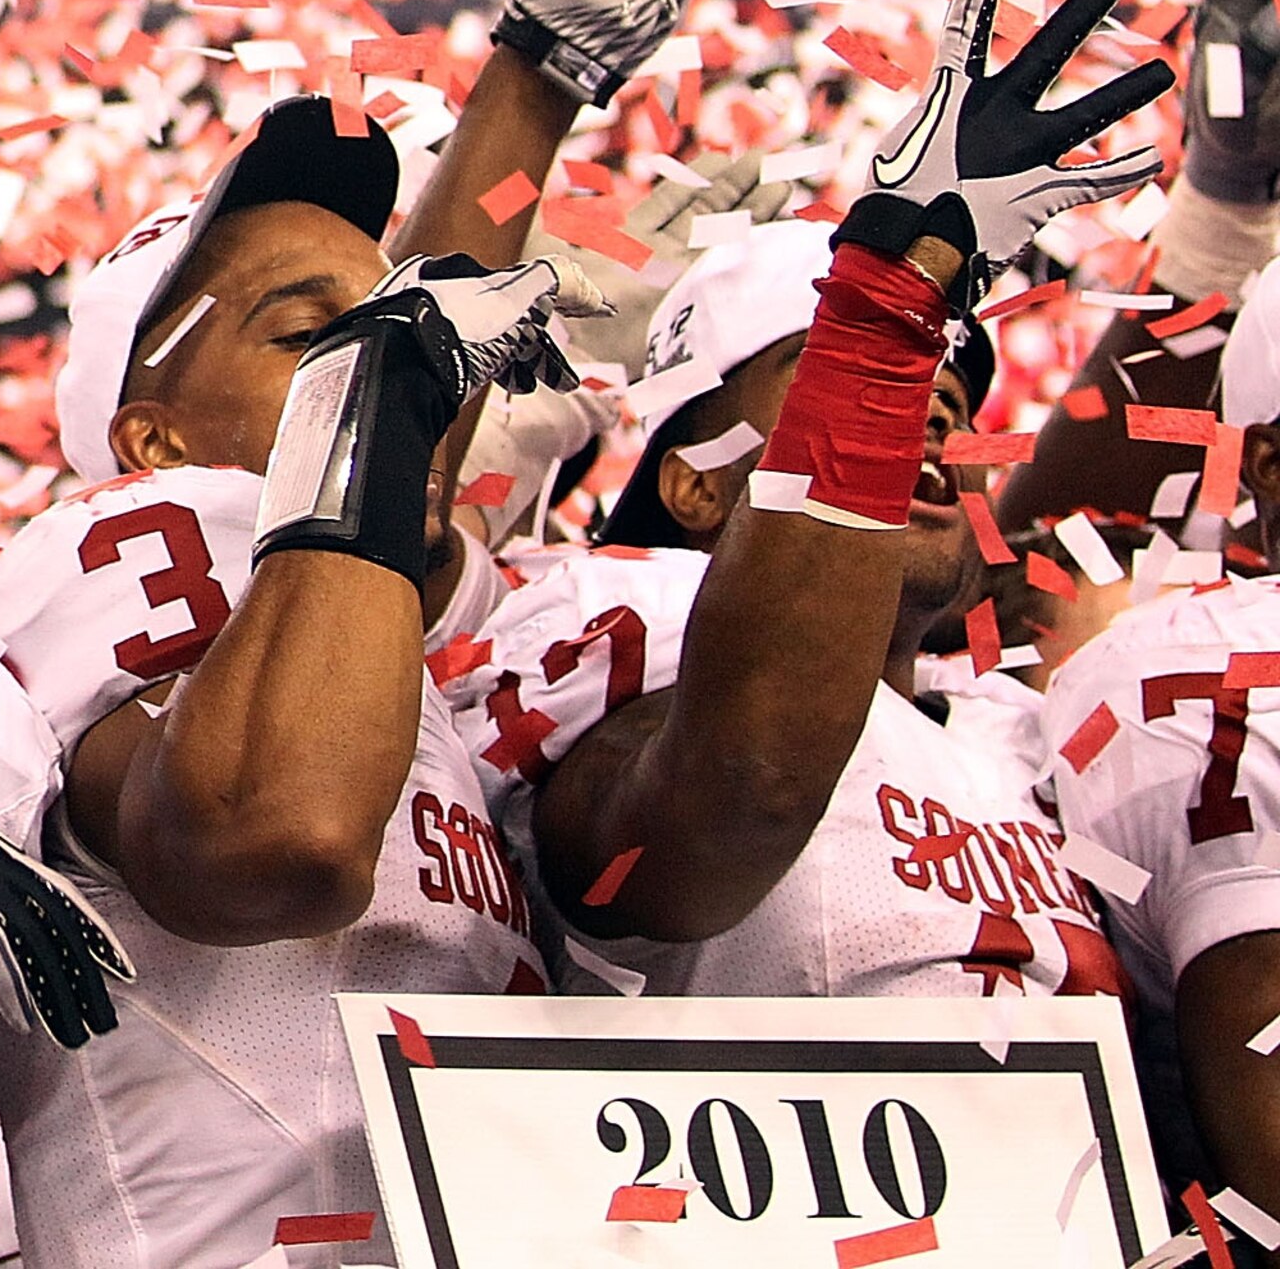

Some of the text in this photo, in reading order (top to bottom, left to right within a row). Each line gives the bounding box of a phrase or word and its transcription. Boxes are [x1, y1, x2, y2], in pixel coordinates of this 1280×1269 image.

[77, 501, 233, 679] 3
[1141, 671, 1255, 846] 7
[595, 1096, 948, 1222] 2010
